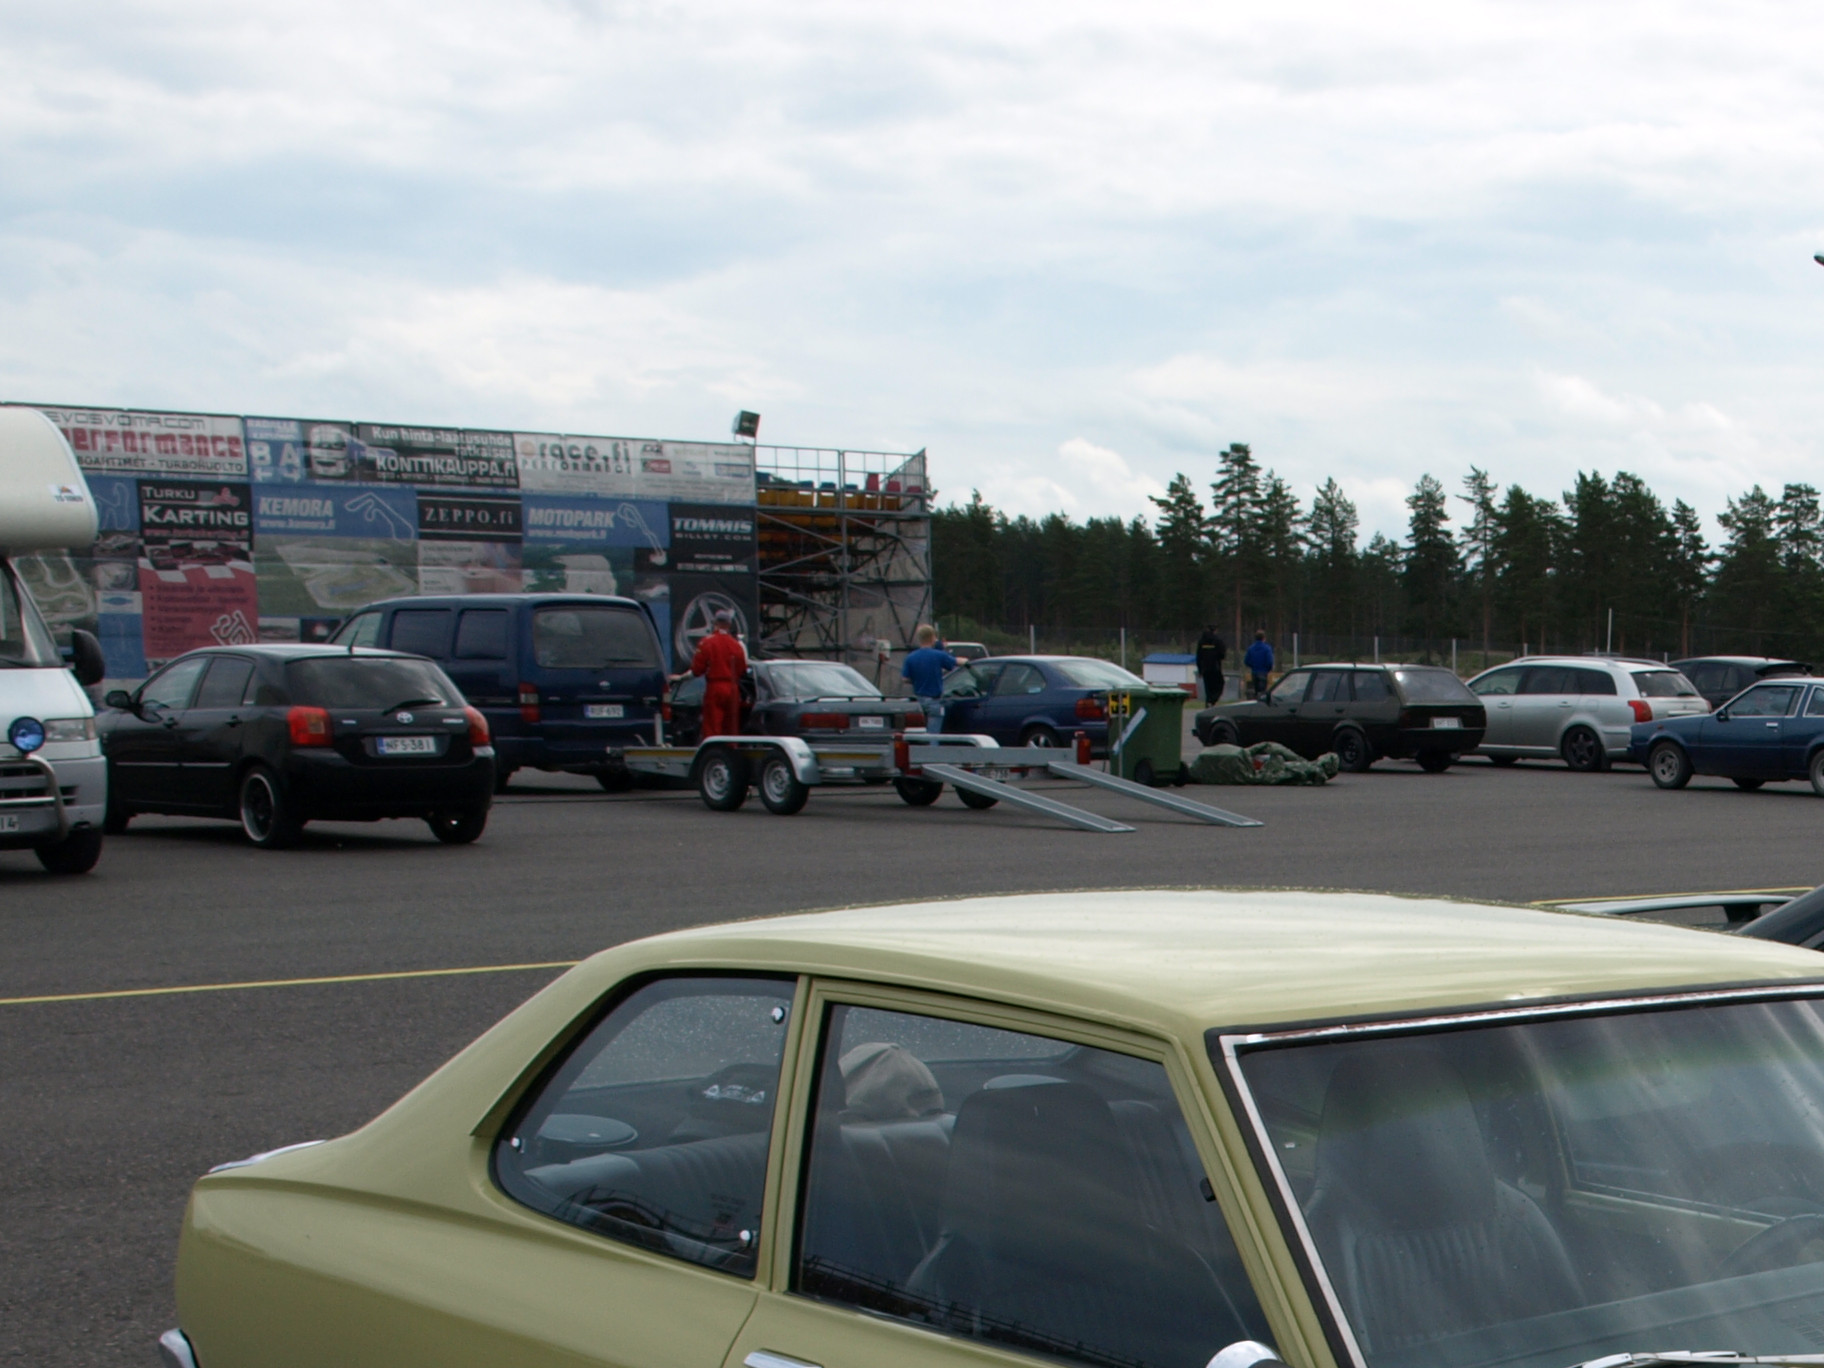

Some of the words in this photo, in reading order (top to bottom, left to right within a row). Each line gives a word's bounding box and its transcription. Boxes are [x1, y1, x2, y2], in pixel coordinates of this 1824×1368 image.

[372, 427, 398, 440] Kun
[401, 428, 512, 446] hinta-laatusuhde
[159, 460, 244, 473] TURBOHUOLTO
[376, 456, 516, 477] KONTTIKAUPPA.fi
[142, 486, 196, 499] TURKU
[144, 505, 249, 526] KARTING
[259, 497, 334, 517] KEMORA
[425, 507, 514, 525] ZEPPO.fi
[528, 507, 616, 529] MOTOPARK
[673, 517, 753, 534] TOMMIS
